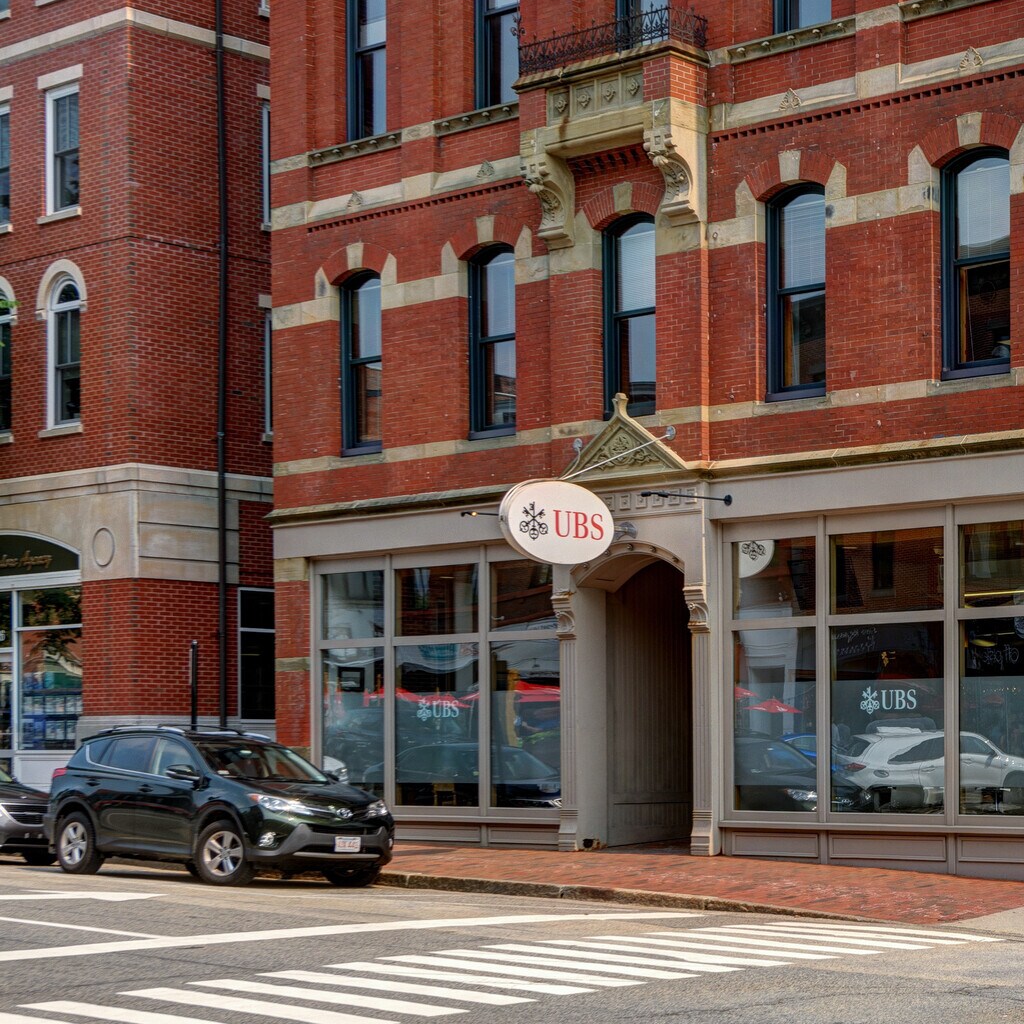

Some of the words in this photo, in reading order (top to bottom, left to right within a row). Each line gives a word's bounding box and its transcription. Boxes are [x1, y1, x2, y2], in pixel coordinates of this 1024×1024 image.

[553, 509, 604, 540] UBS
[432, 700, 459, 718] UBS
[881, 689, 917, 710] UBS
